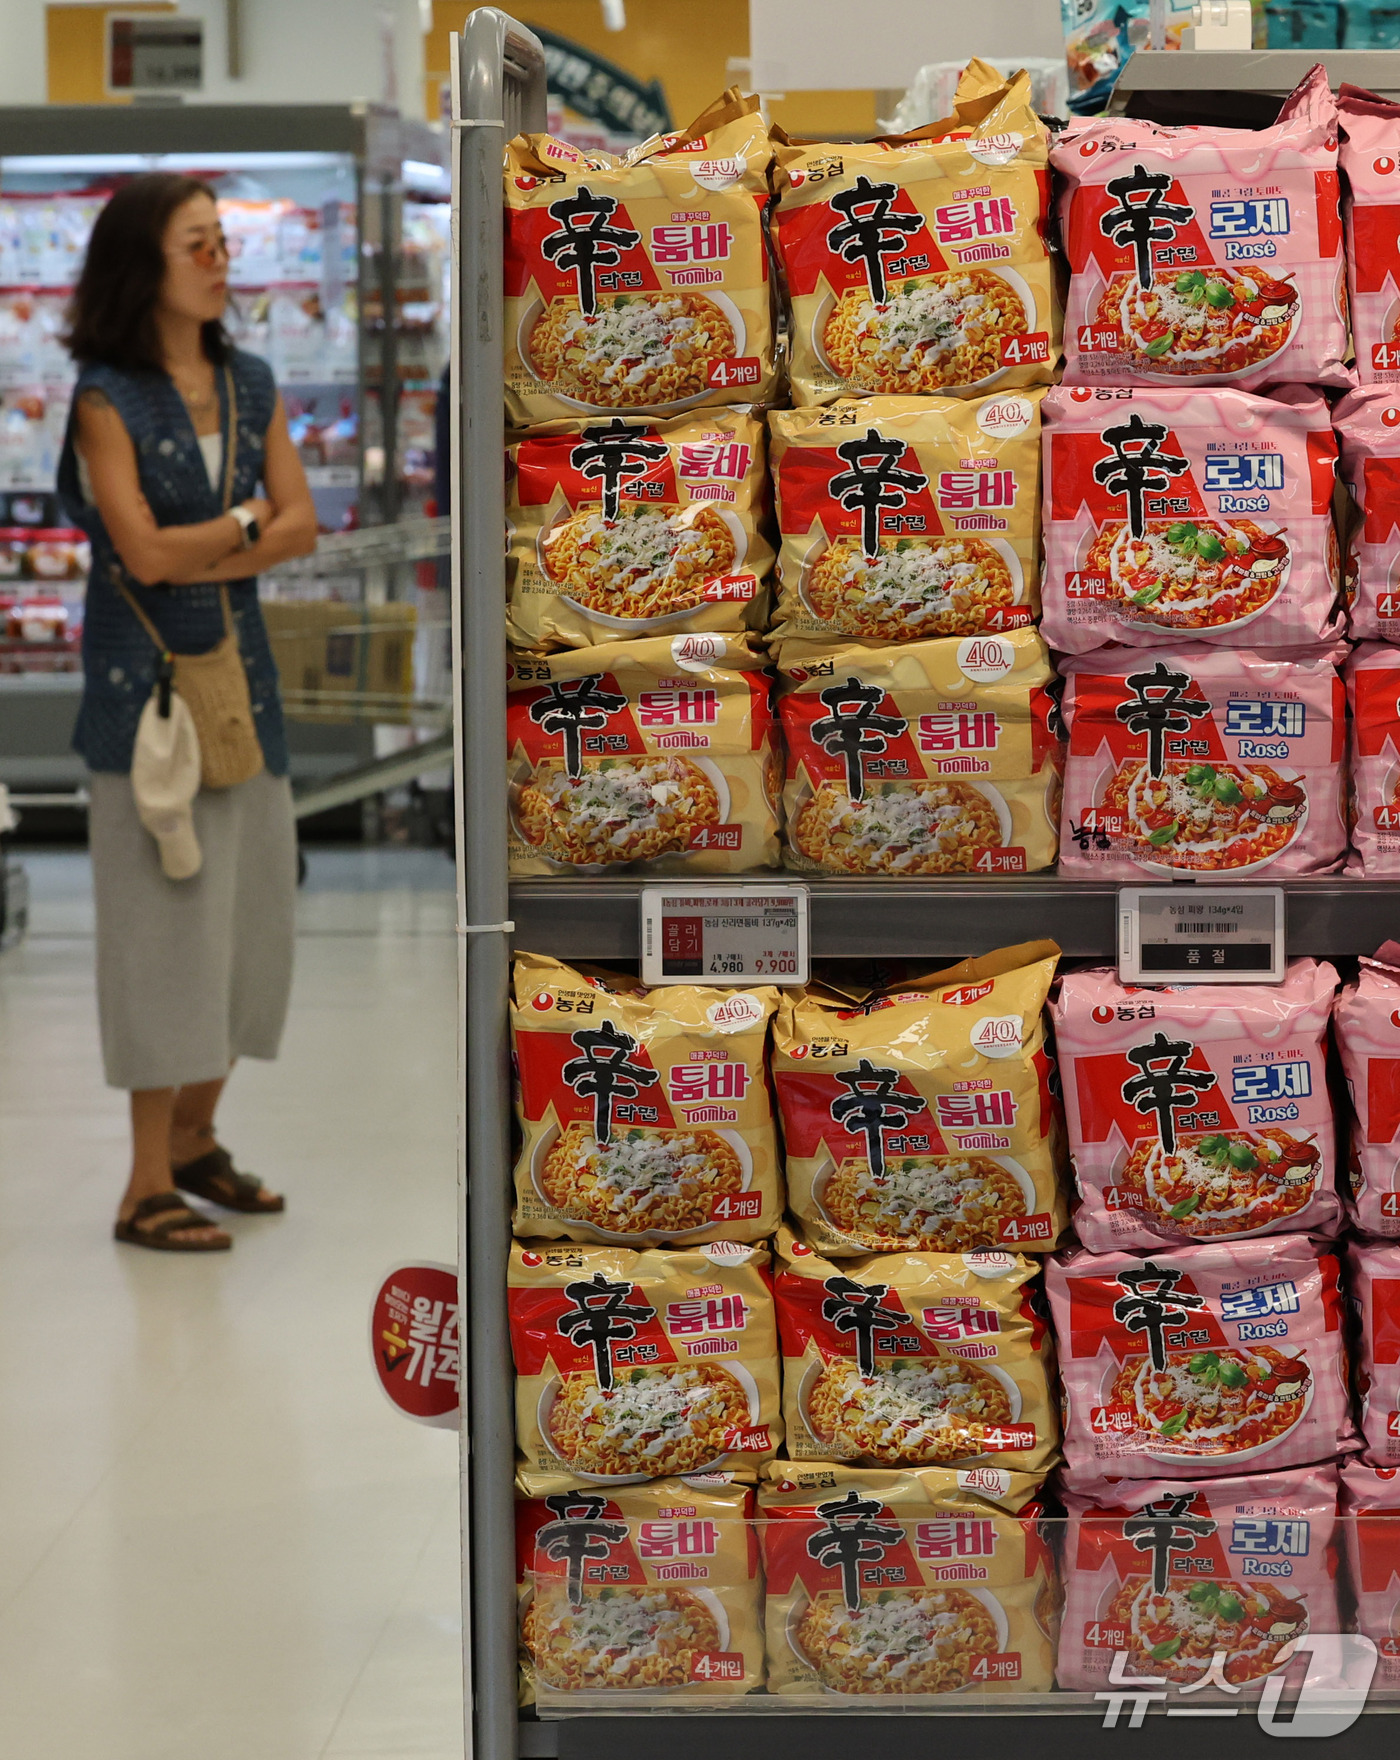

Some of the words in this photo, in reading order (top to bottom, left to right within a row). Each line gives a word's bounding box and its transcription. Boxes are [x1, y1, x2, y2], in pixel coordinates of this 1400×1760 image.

[808, 163, 844, 181] 농심
[936, 197, 1016, 244] 툼바
[1100, 165, 1195, 290] 辛
[1210, 199, 1289, 238] 로제
[651, 224, 733, 262] 툼바
[829, 176, 924, 304] 辛
[1226, 241, 1275, 260] Rosé
[543, 187, 641, 315] 辛
[951, 243, 1009, 264] Toomba
[1156, 248, 1196, 264] 라면
[889, 256, 929, 274] 라면
[600, 272, 642, 288] 라면
[666, 268, 723, 285] Toomba
[1080, 327, 1116, 349] 4개입
[1004, 337, 1047, 361] 4개입
[711, 360, 757, 385] 4개입
[1095, 387, 1133, 400] 농심
[818, 412, 856, 426] 농심
[986, 402, 1022, 423] 40
[570, 418, 670, 521] 辛
[678, 443, 751, 480] 툼바
[1094, 413, 1190, 538] 辛
[1204, 454, 1284, 491] 로제
[625, 482, 664, 497] 라면
[686, 484, 735, 503] Toomba
[829, 428, 929, 558] 辛
[938, 471, 1017, 509] 툼바
[1149, 498, 1190, 514] 라면
[1219, 495, 1269, 512] Rosé
[884, 516, 926, 531] 라면
[950, 514, 1007, 530] Toomba
[707, 580, 752, 599] 4개입
[1068, 575, 1106, 596] 4개입
[986, 611, 1031, 629] 4개입
[967, 641, 1002, 666] 40
[516, 665, 551, 680] 농심
[637, 690, 722, 727] 툼바
[1225, 700, 1305, 738] 로제
[1116, 662, 1212, 780] 辛
[587, 735, 628, 752] 라면
[651, 731, 710, 748] Toomba
[811, 677, 908, 803] 辛
[917, 713, 1002, 754] 툼바
[1169, 740, 1209, 755] 라면
[1238, 740, 1289, 758] Rosé
[867, 760, 908, 775] 라면
[932, 756, 990, 774] Toomba
[693, 828, 738, 848] 4개입
[977, 850, 1022, 871] 4개입
[704, 919, 719, 927] 농심
[755, 960, 796, 973] 9,900
[945, 984, 991, 1005] 4개입
[556, 999, 594, 1014] 농심
[714, 998, 750, 1023] 40
[1117, 1005, 1155, 1021] 농심
[978, 1021, 1015, 1042] 40
[811, 1042, 848, 1058] 농심
[563, 1019, 660, 1144] 辛
[667, 1063, 751, 1104] 툼바
[1232, 1061, 1312, 1103] 로제
[1121, 1033, 1218, 1156] 辛
[617, 1105, 658, 1122] 라면
[681, 1105, 737, 1124] Toomba
[831, 1059, 927, 1179] 辛
[936, 1091, 1018, 1129] 툼바
[1179, 1111, 1219, 1128] 라면
[1249, 1102, 1298, 1123] Rosé
[888, 1135, 929, 1153] 라면
[952, 1133, 1009, 1151] Toomba
[714, 1197, 758, 1218] 4개입
[1107, 1187, 1143, 1208] 4개입
[1003, 1218, 1050, 1240] 4개입
[1220, 1280, 1300, 1321] 로제
[665, 1294, 749, 1337] 툼바
[921, 1307, 1000, 1342] 툼바
[1113, 1262, 1205, 1371] 辛
[558, 1273, 657, 1391] 辛
[1169, 1330, 1210, 1347] 라면
[1239, 1320, 1288, 1340] Rosé
[616, 1344, 657, 1363] 라면
[681, 1337, 738, 1356] Toomba
[879, 1337, 920, 1352] 라면
[1094, 1409, 1132, 1431] 4개입
[728, 1431, 768, 1451] 4개입
[965, 1469, 1000, 1490] 40
[537, 1491, 630, 1606] 辛
[638, 1519, 721, 1559] 툼바
[915, 1520, 998, 1558] 툼바
[1230, 1520, 1310, 1556] 로제
[807, 1491, 906, 1612] 辛
[588, 1565, 630, 1581] 라면
[651, 1563, 708, 1580] Toomba
[864, 1567, 906, 1584] 라면
[930, 1563, 988, 1581] Toomba
[1174, 1557, 1214, 1573] 라면
[1243, 1558, 1292, 1576] Rosé
[1086, 1624, 1124, 1645] 4개입
[695, 1655, 740, 1678] 4개입
[973, 1658, 1018, 1679] 4개입
